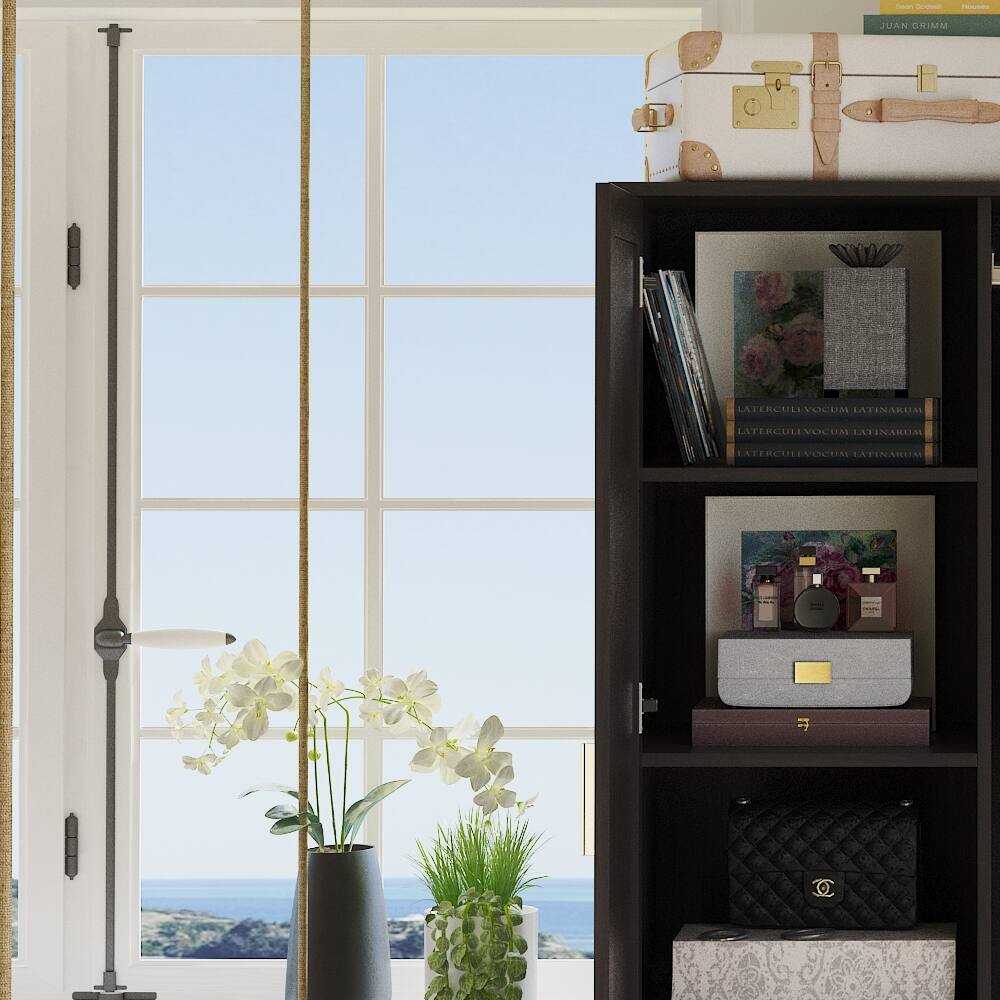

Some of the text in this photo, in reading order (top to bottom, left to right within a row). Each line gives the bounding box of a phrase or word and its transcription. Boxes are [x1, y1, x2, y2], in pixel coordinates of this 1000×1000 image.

[879, 22, 949, 31] JUAN GRIMM
[737, 405, 923, 414] LATERCULI VOCUM LATINARUM
[737, 427, 923, 437] LATERCULI VOCUM LATINARUM
[737, 449, 923, 459] LATERCULI VOCUM LATINARUM
